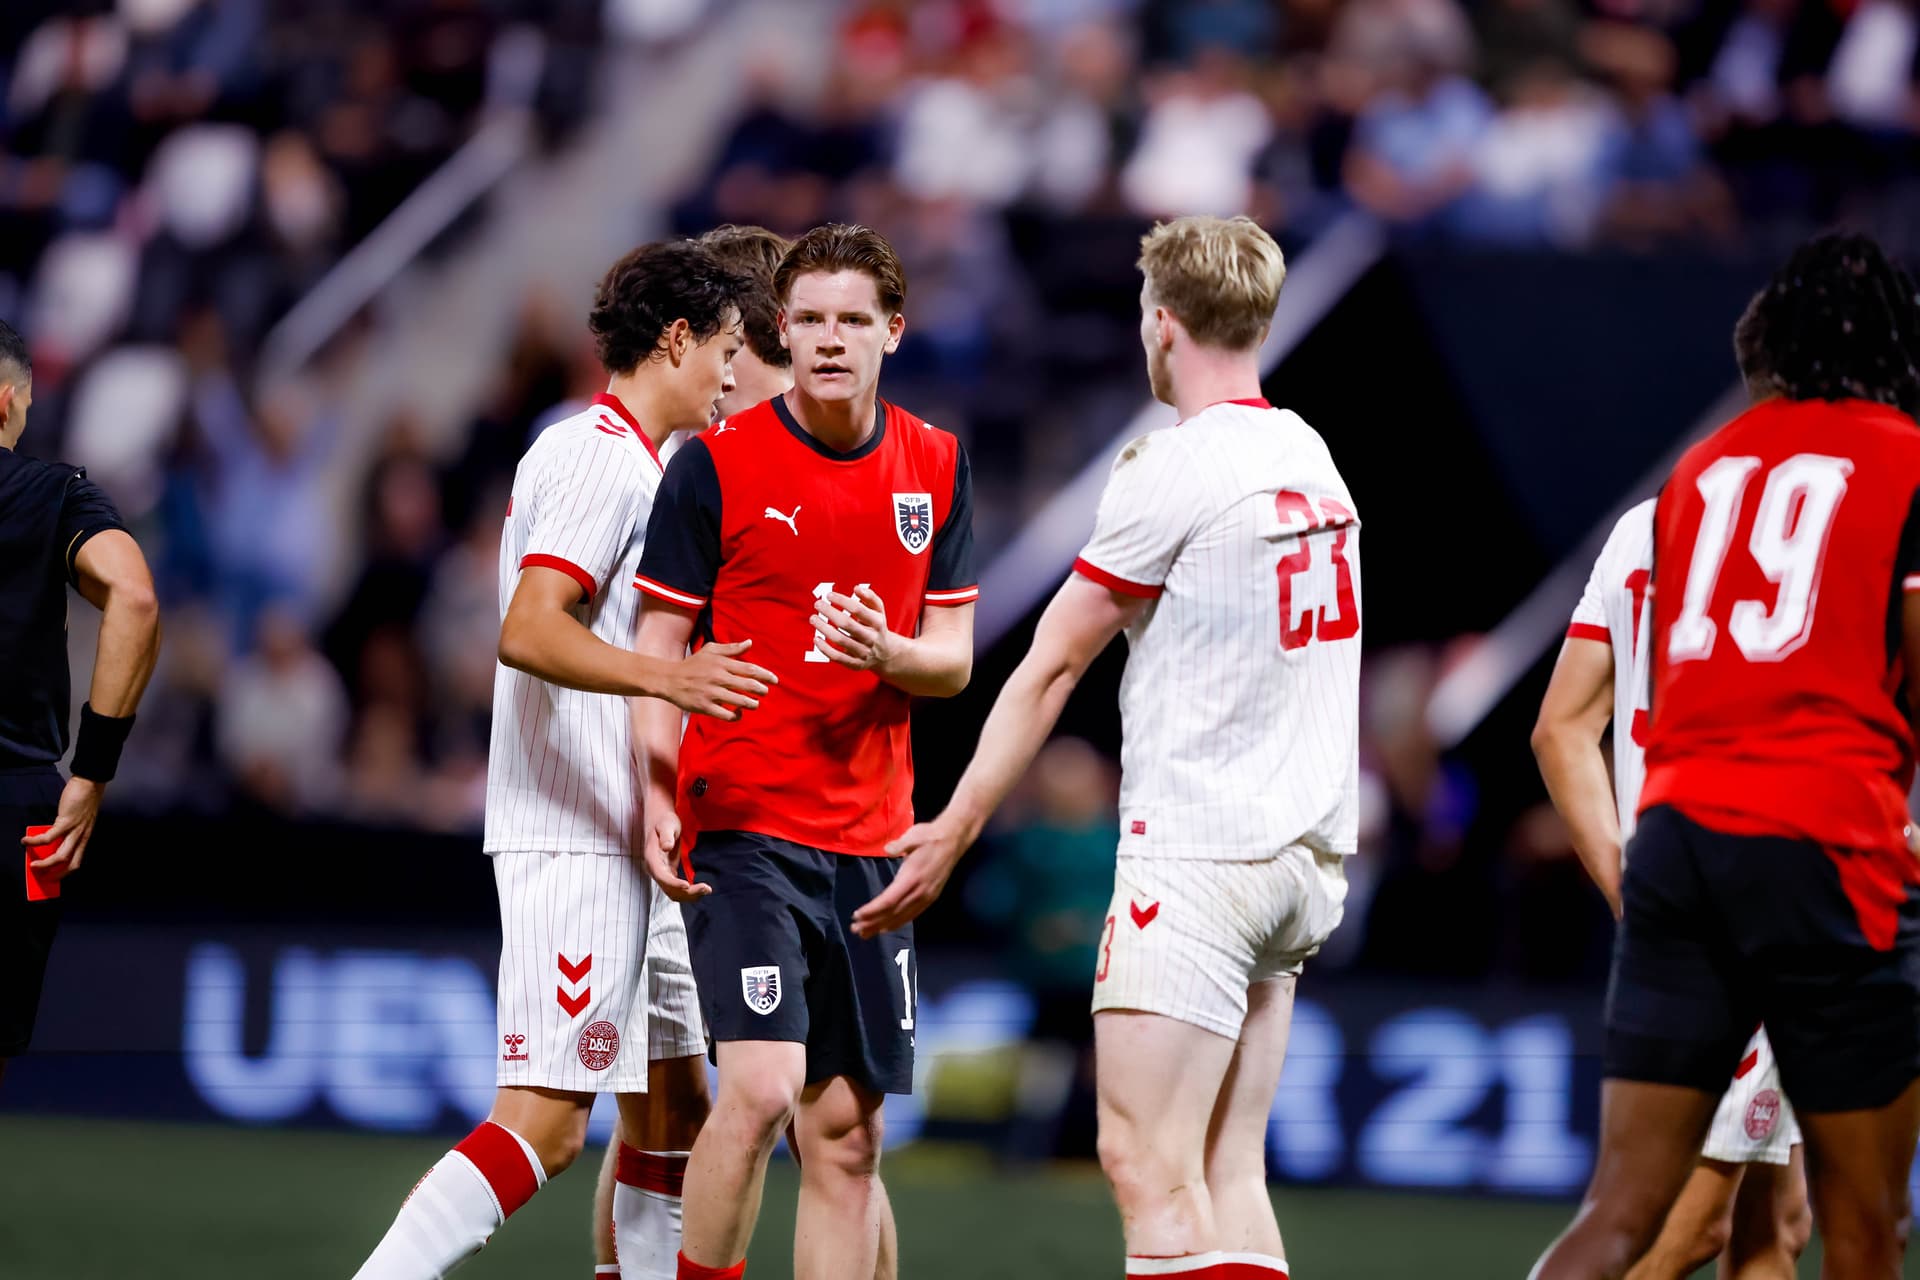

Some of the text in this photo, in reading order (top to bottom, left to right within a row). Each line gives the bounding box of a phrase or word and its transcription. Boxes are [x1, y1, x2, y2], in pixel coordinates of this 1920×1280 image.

[1275, 489, 1360, 652] 23
[1667, 453, 1855, 664] 19
[587, 1037, 612, 1052] DBU
[894, 948, 918, 1030] 1
[503, 1052, 528, 1061] hummel
[1360, 1008, 1592, 1186] 21
